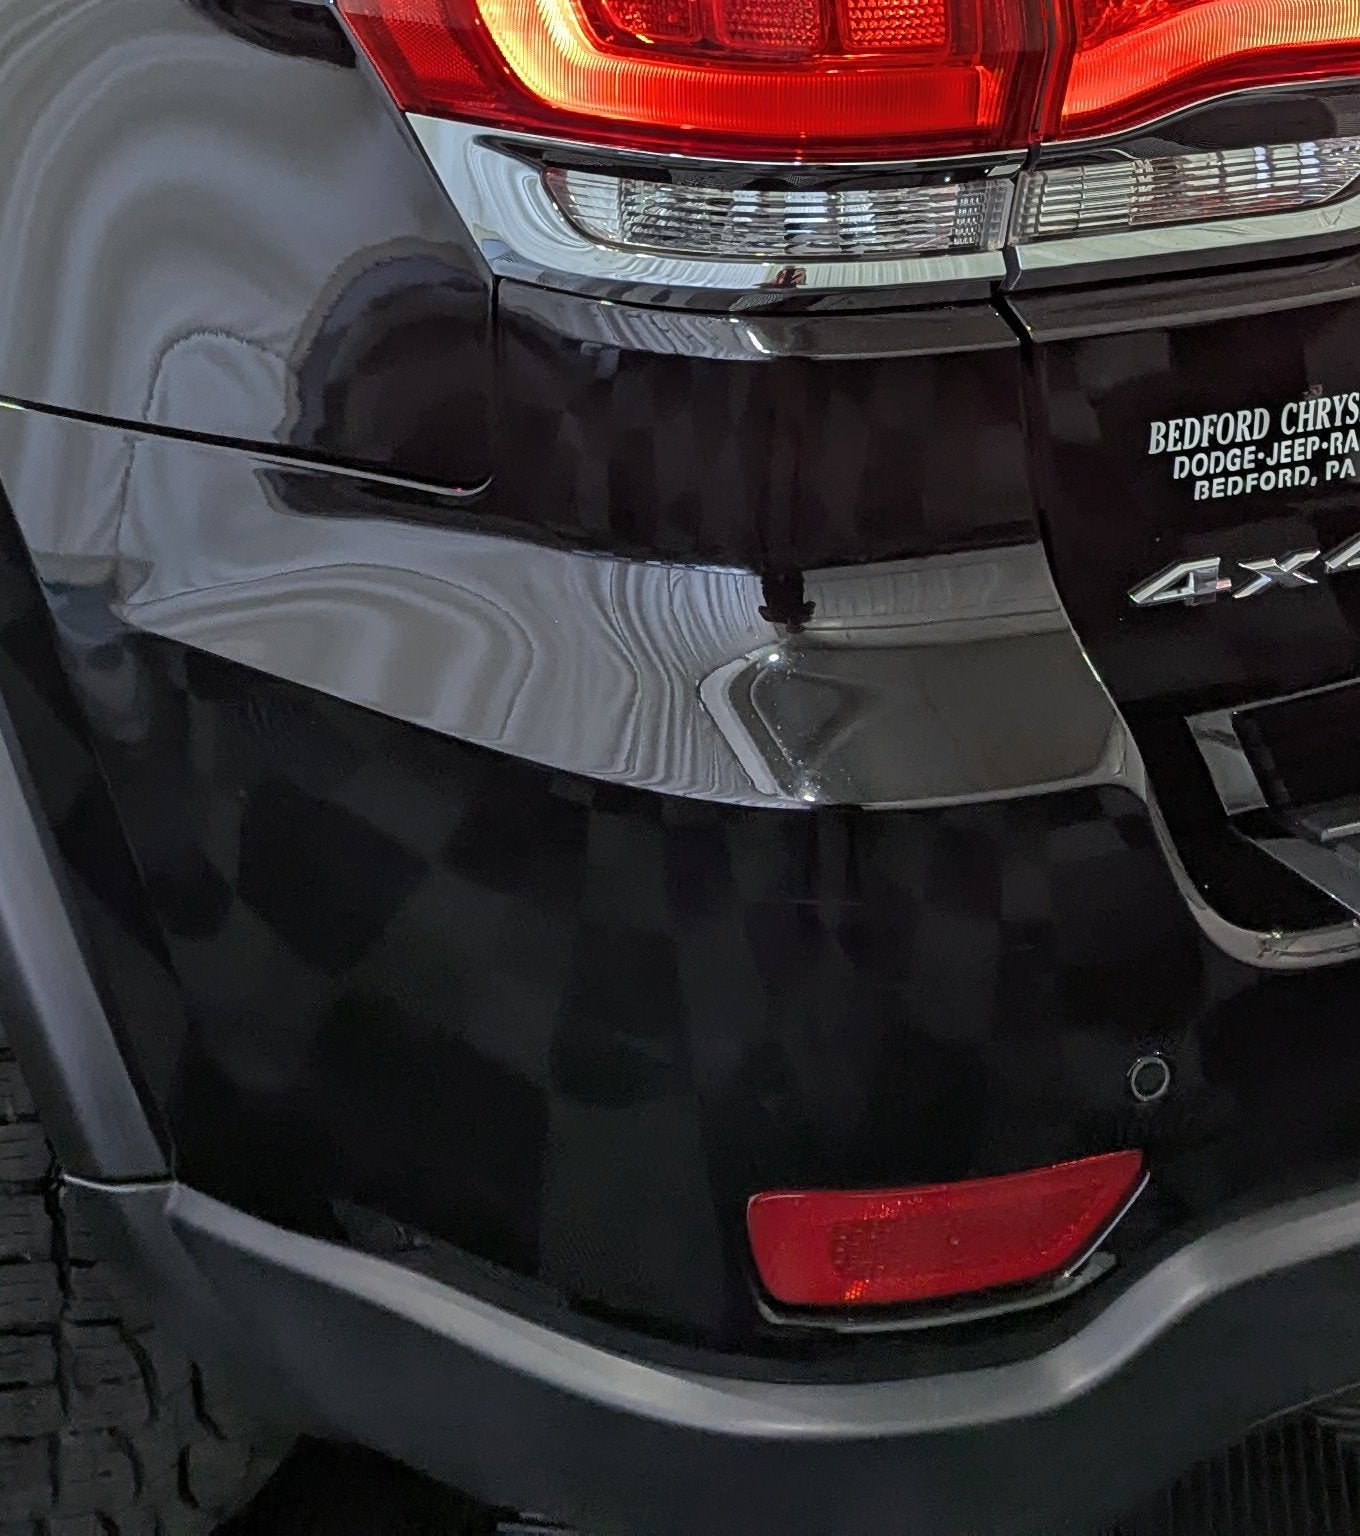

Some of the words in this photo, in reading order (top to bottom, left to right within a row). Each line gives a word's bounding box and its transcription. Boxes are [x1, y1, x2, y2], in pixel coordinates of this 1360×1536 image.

[1148, 408, 1270, 455] BEDFORD
[1194, 465, 1318, 501] BEDFORD,
[1325, 458, 1356, 481] PA
